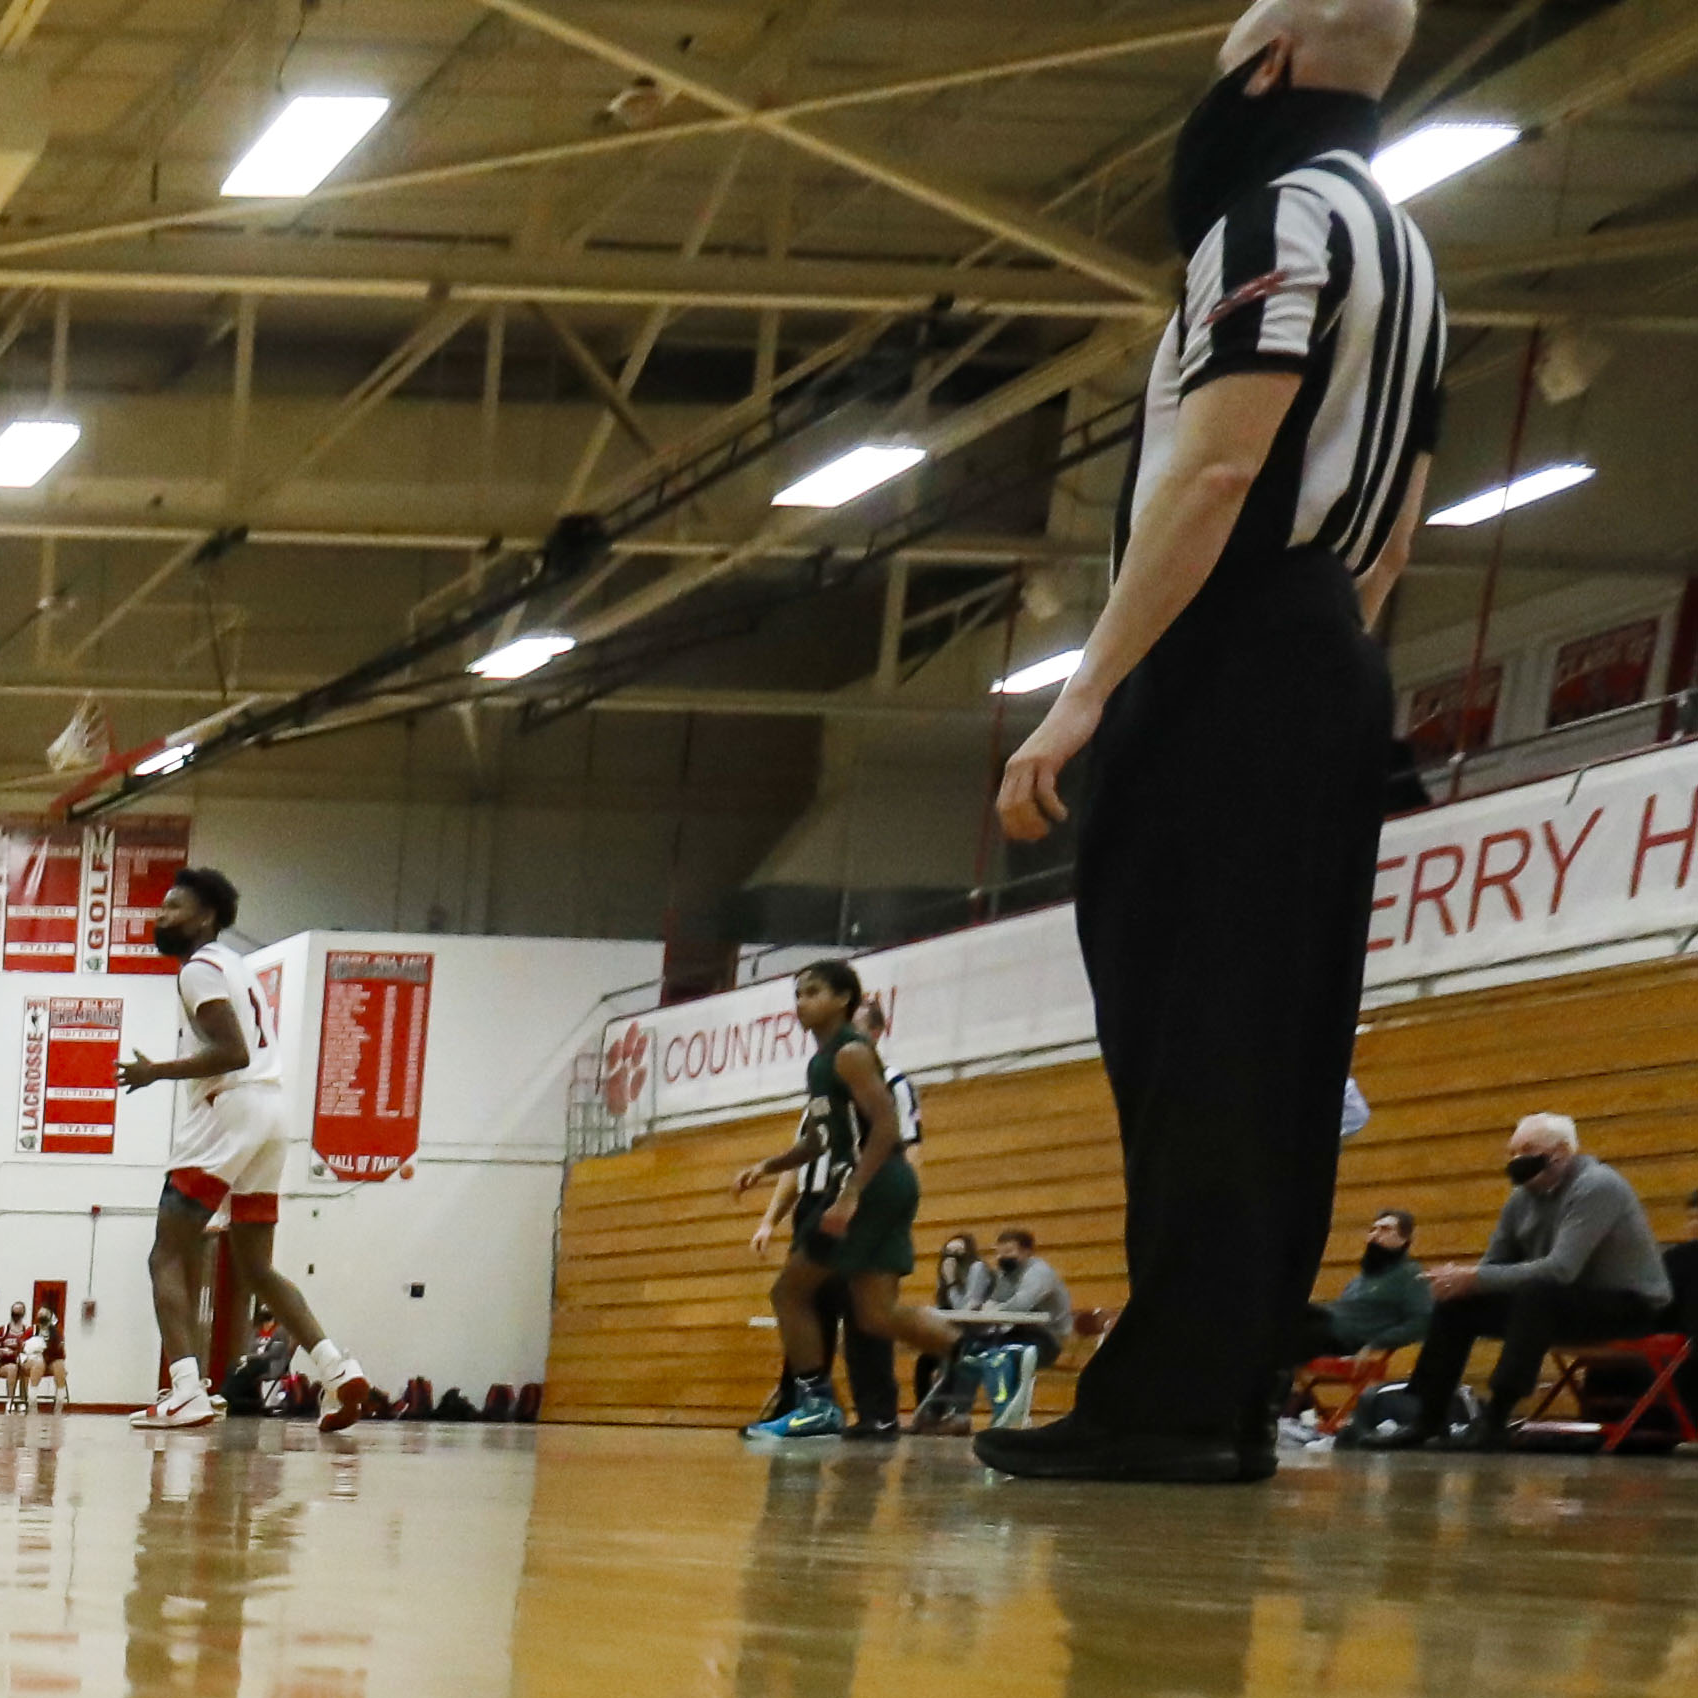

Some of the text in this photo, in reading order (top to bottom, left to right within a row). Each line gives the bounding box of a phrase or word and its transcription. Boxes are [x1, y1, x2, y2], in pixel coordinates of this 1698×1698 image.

[1366, 806, 1605, 952] ERRY
[87, 853, 109, 950] GOLF
[19, 943, 61, 952] STATE
[53, 1009, 121, 1027] CHAMPIONS
[53, 1029, 116, 1038] CONFERENCE
[22, 1032, 44, 1131] LACROSSE
[54, 1089, 107, 1097] SECTIONAL
[328, 1154, 402, 1172] HALL OF FAME
